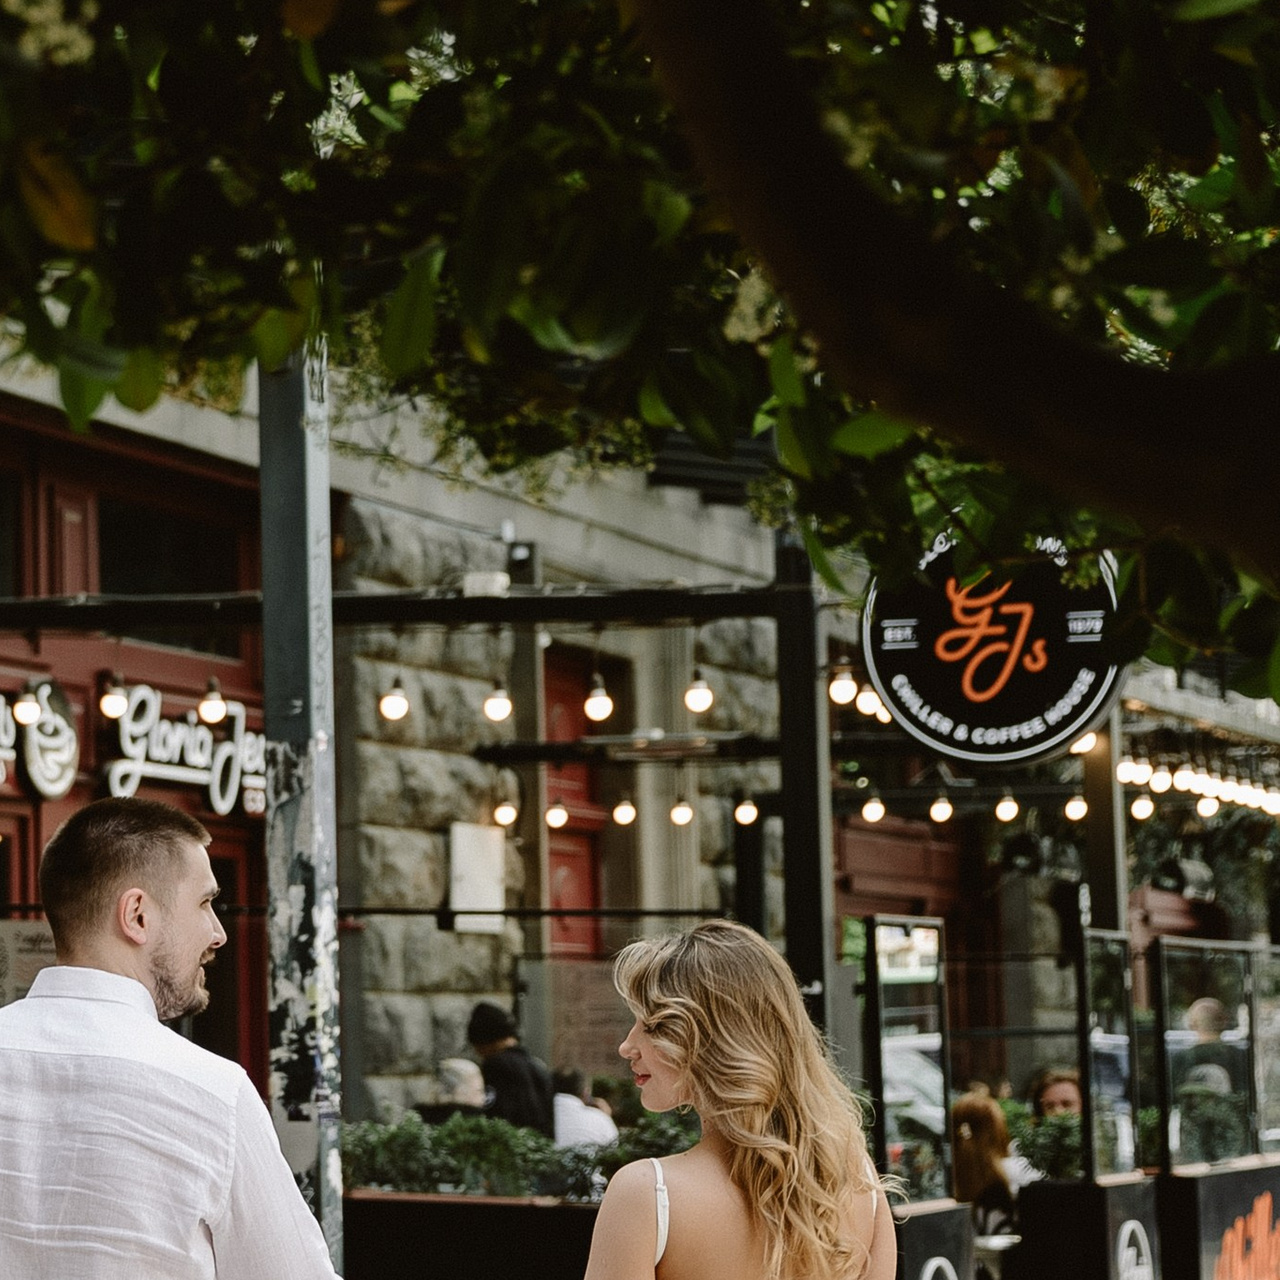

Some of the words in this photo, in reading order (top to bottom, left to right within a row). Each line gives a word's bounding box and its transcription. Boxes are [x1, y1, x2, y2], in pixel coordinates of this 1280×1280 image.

[891, 673, 955, 736] CHILLER
[971, 715, 1047, 746] COFFEE
[1043, 667, 1096, 727] HOUSE
